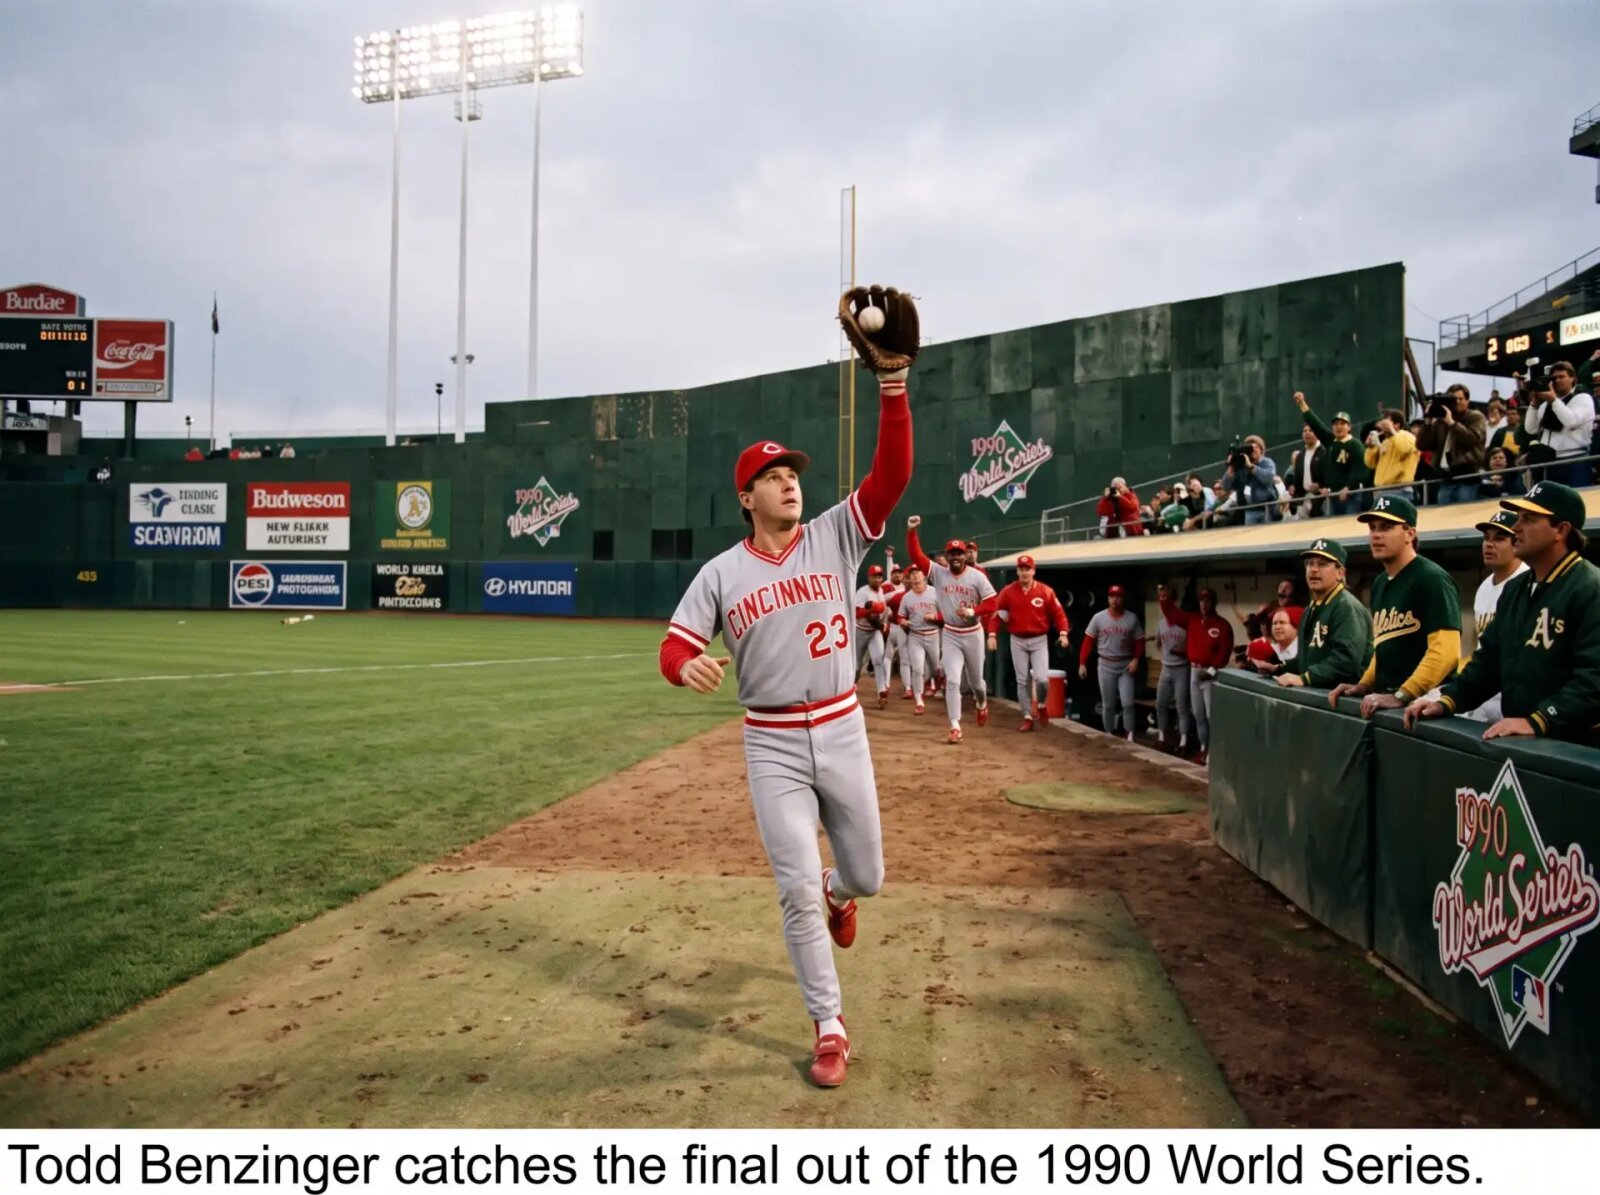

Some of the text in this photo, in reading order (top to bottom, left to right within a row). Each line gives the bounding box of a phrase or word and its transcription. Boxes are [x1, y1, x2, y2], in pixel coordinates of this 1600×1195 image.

[1487, 337, 1498, 361] 2
[971, 437, 1006, 457] 1990
[252, 488, 345, 509] Budweson
[515, 489, 543, 504] 1990
[266, 521, 290, 532] NEW
[377, 564, 410, 575] WORLD
[237, 578, 270, 589] PESI
[508, 580, 572, 596] HYUNDAI
[726, 573, 843, 640] CINCINNATI
[804, 613, 849, 660] 23
[1525, 607, 1565, 650] A's
[1456, 788, 1508, 857] 1990
[1434, 843, 1584, 971] World Series
